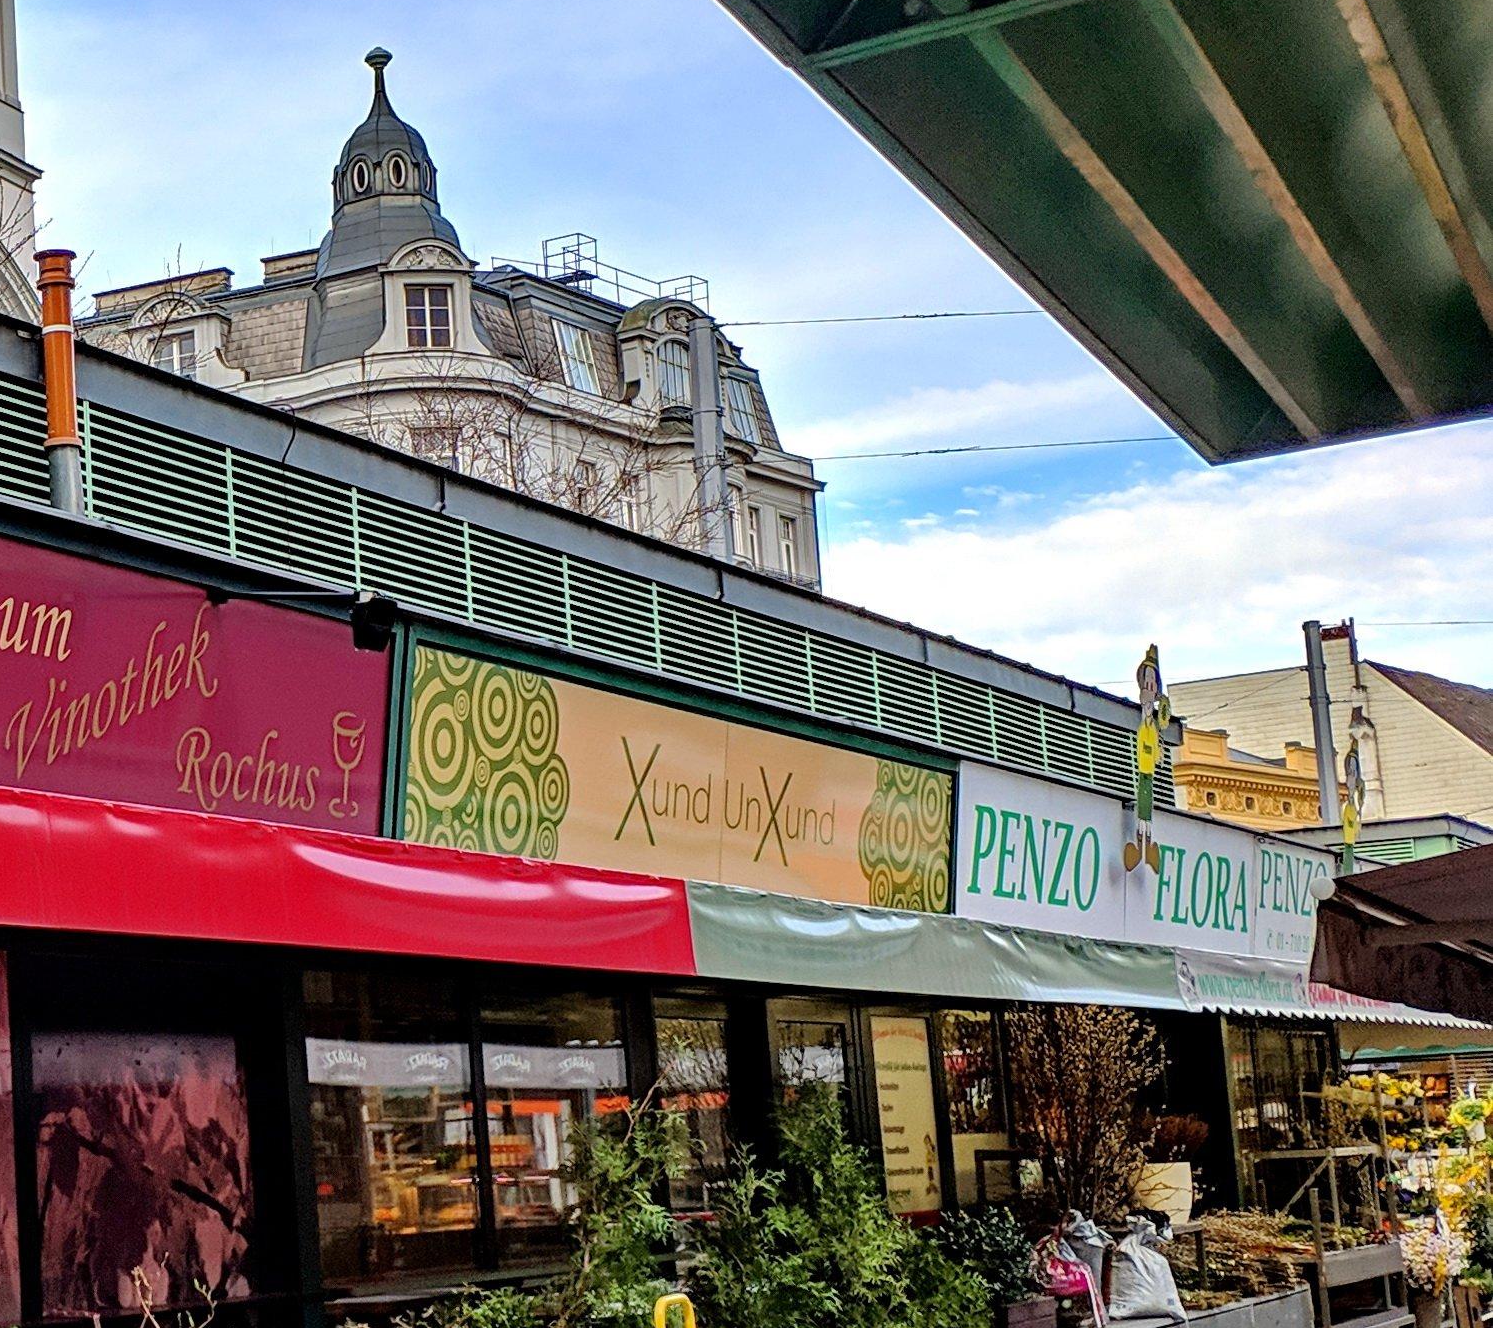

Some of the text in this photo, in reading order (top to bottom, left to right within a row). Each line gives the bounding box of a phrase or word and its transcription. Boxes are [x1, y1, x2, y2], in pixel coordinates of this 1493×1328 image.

[4, 601, 219, 780] Vinothek
[176, 725, 321, 812] Rochus
[614, 736, 837, 867] Xund UnXund
[967, 804, 1249, 933] PENZO FLORA
